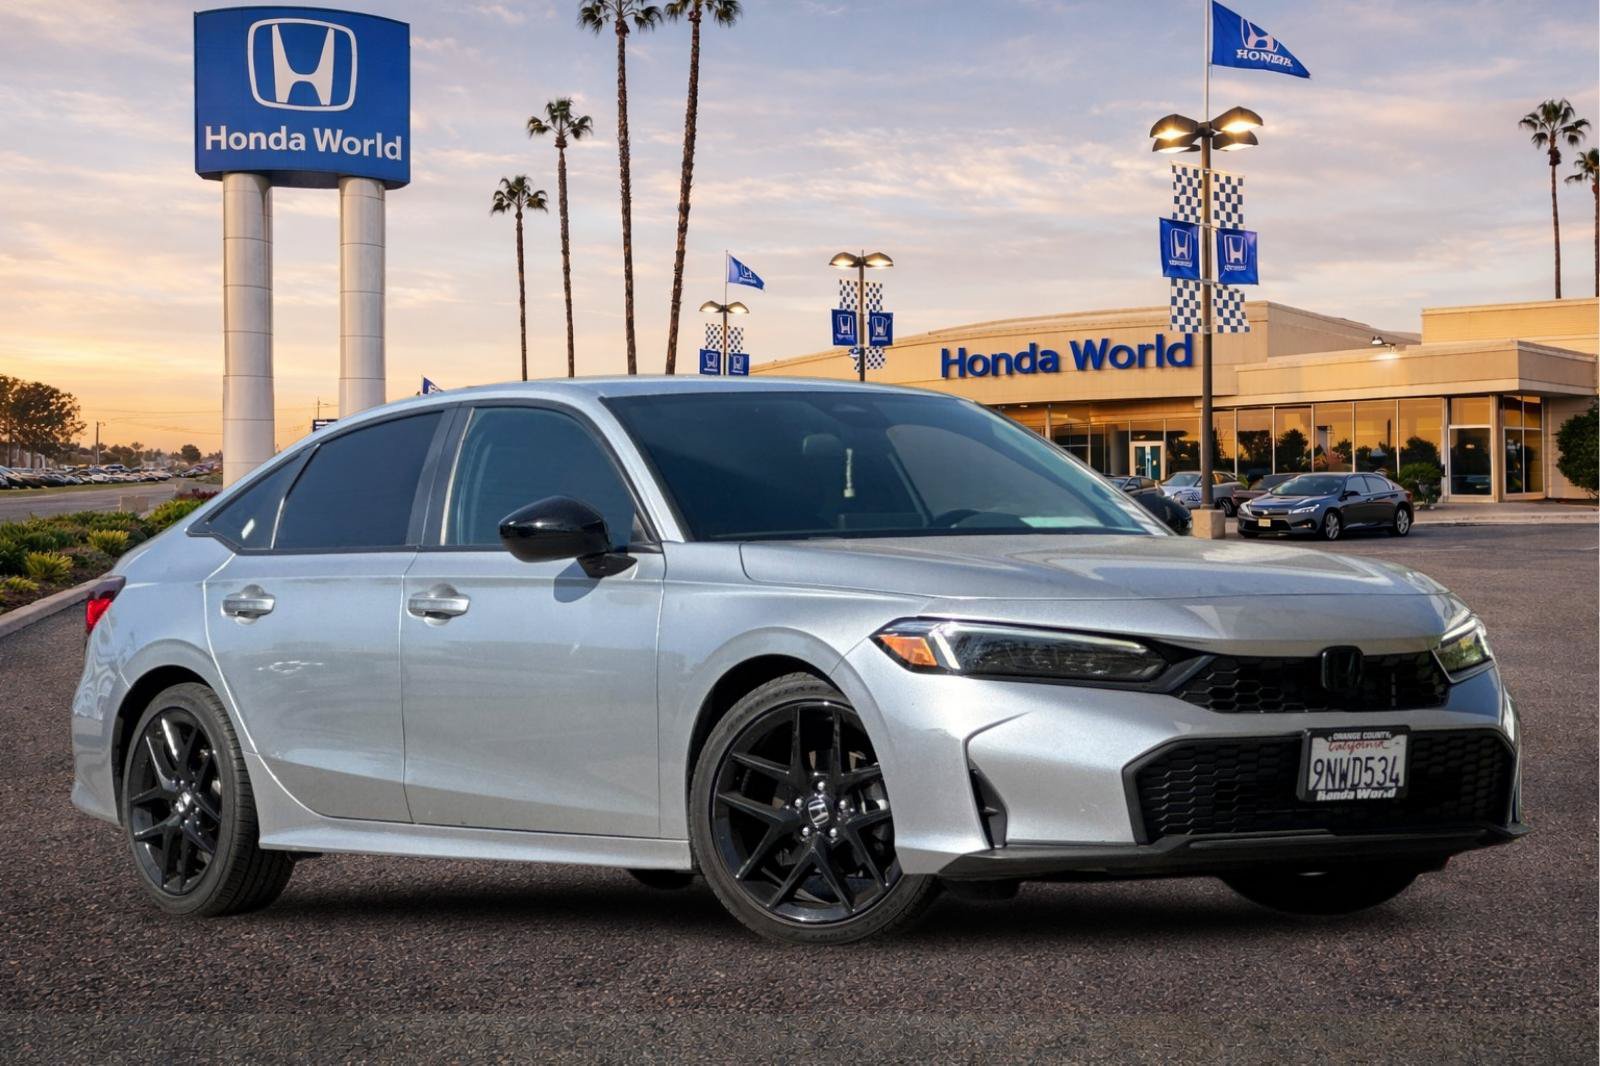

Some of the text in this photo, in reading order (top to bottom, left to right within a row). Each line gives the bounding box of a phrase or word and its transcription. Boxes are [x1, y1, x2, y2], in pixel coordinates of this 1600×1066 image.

[205, 125, 402, 161] Honda World
[941, 333, 1194, 378] Honda World
[1312, 755, 1400, 790] 9NWD534
